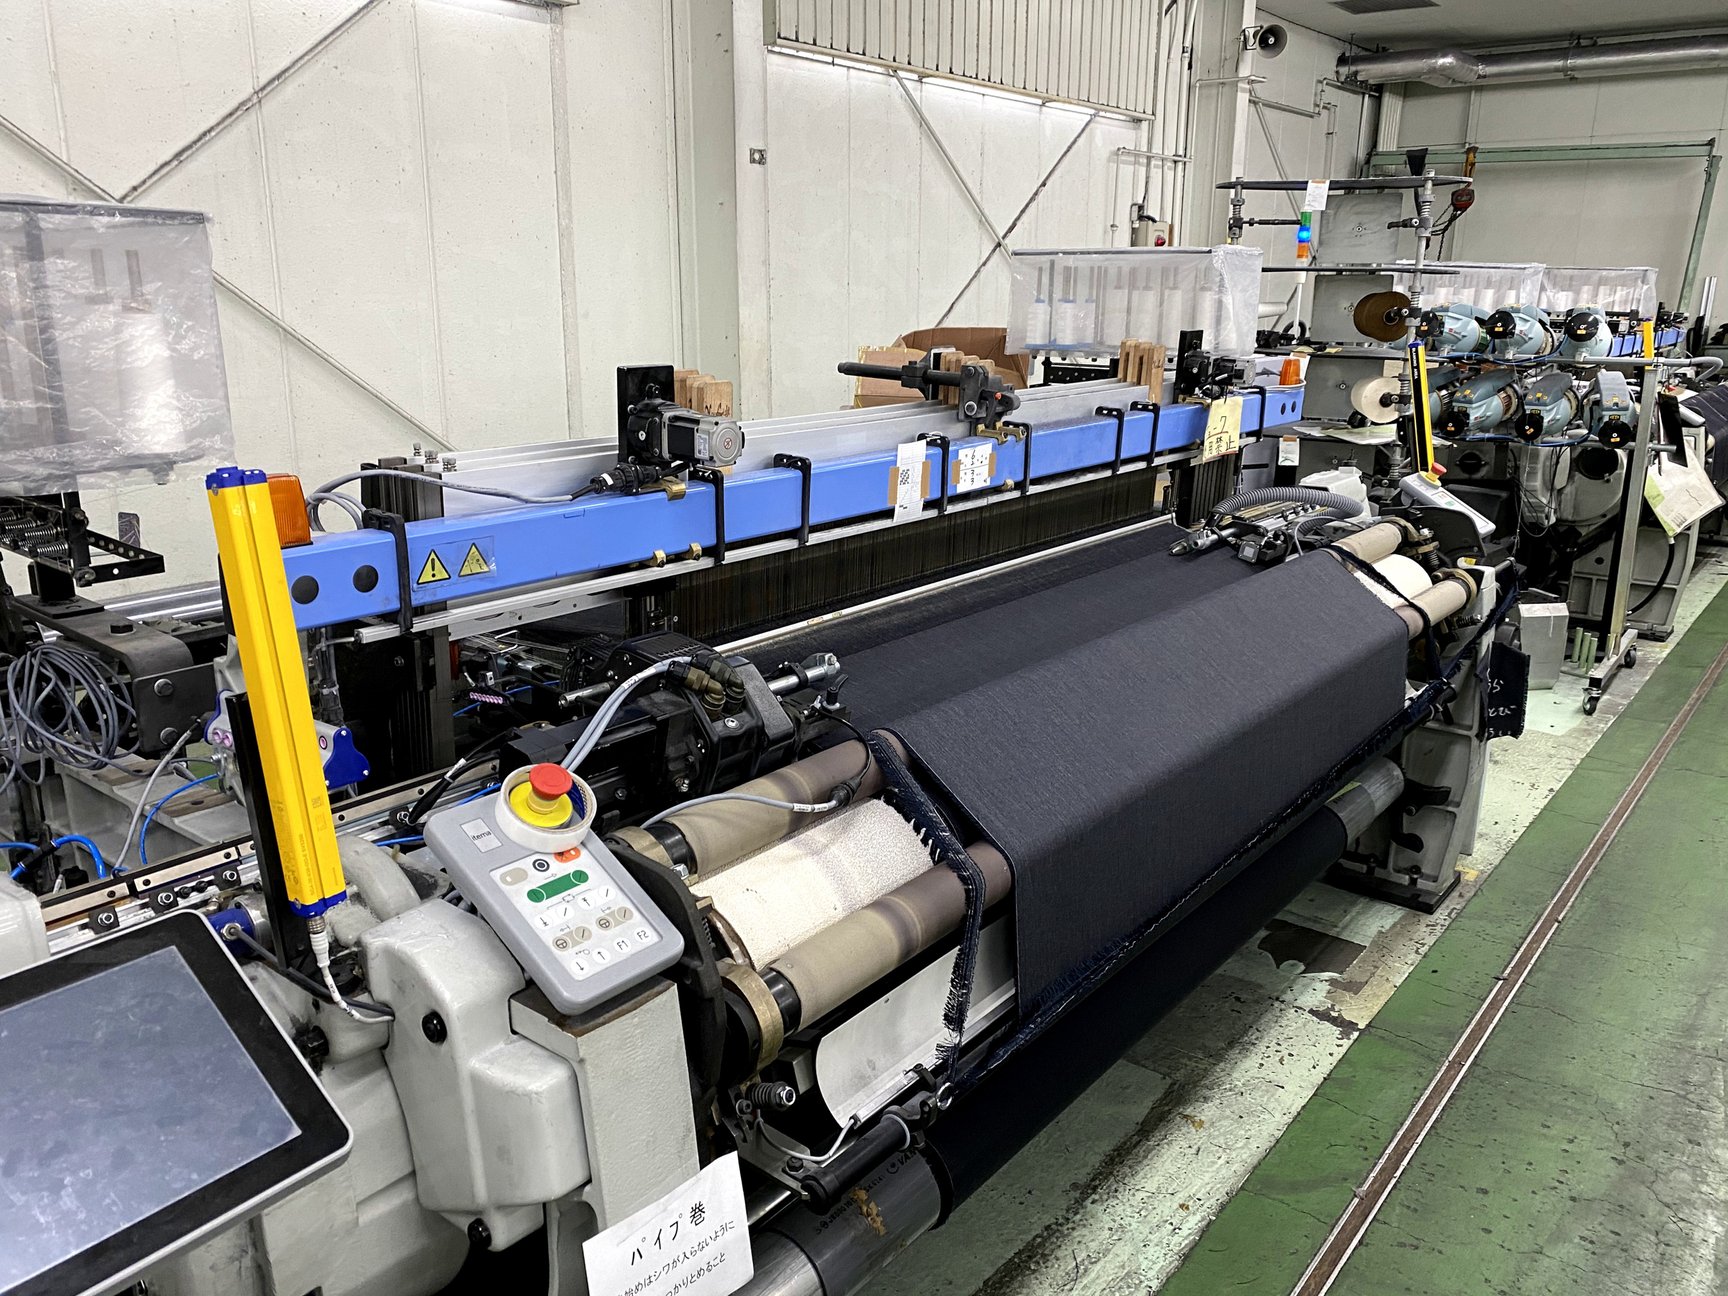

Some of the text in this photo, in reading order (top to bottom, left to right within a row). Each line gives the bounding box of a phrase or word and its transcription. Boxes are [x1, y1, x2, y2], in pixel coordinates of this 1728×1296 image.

[470, 830, 492, 842] itema
[636, 929, 649, 940] F2
[616, 940, 628, 952] F1
[631, 1200, 706, 1266] パイプ巻
